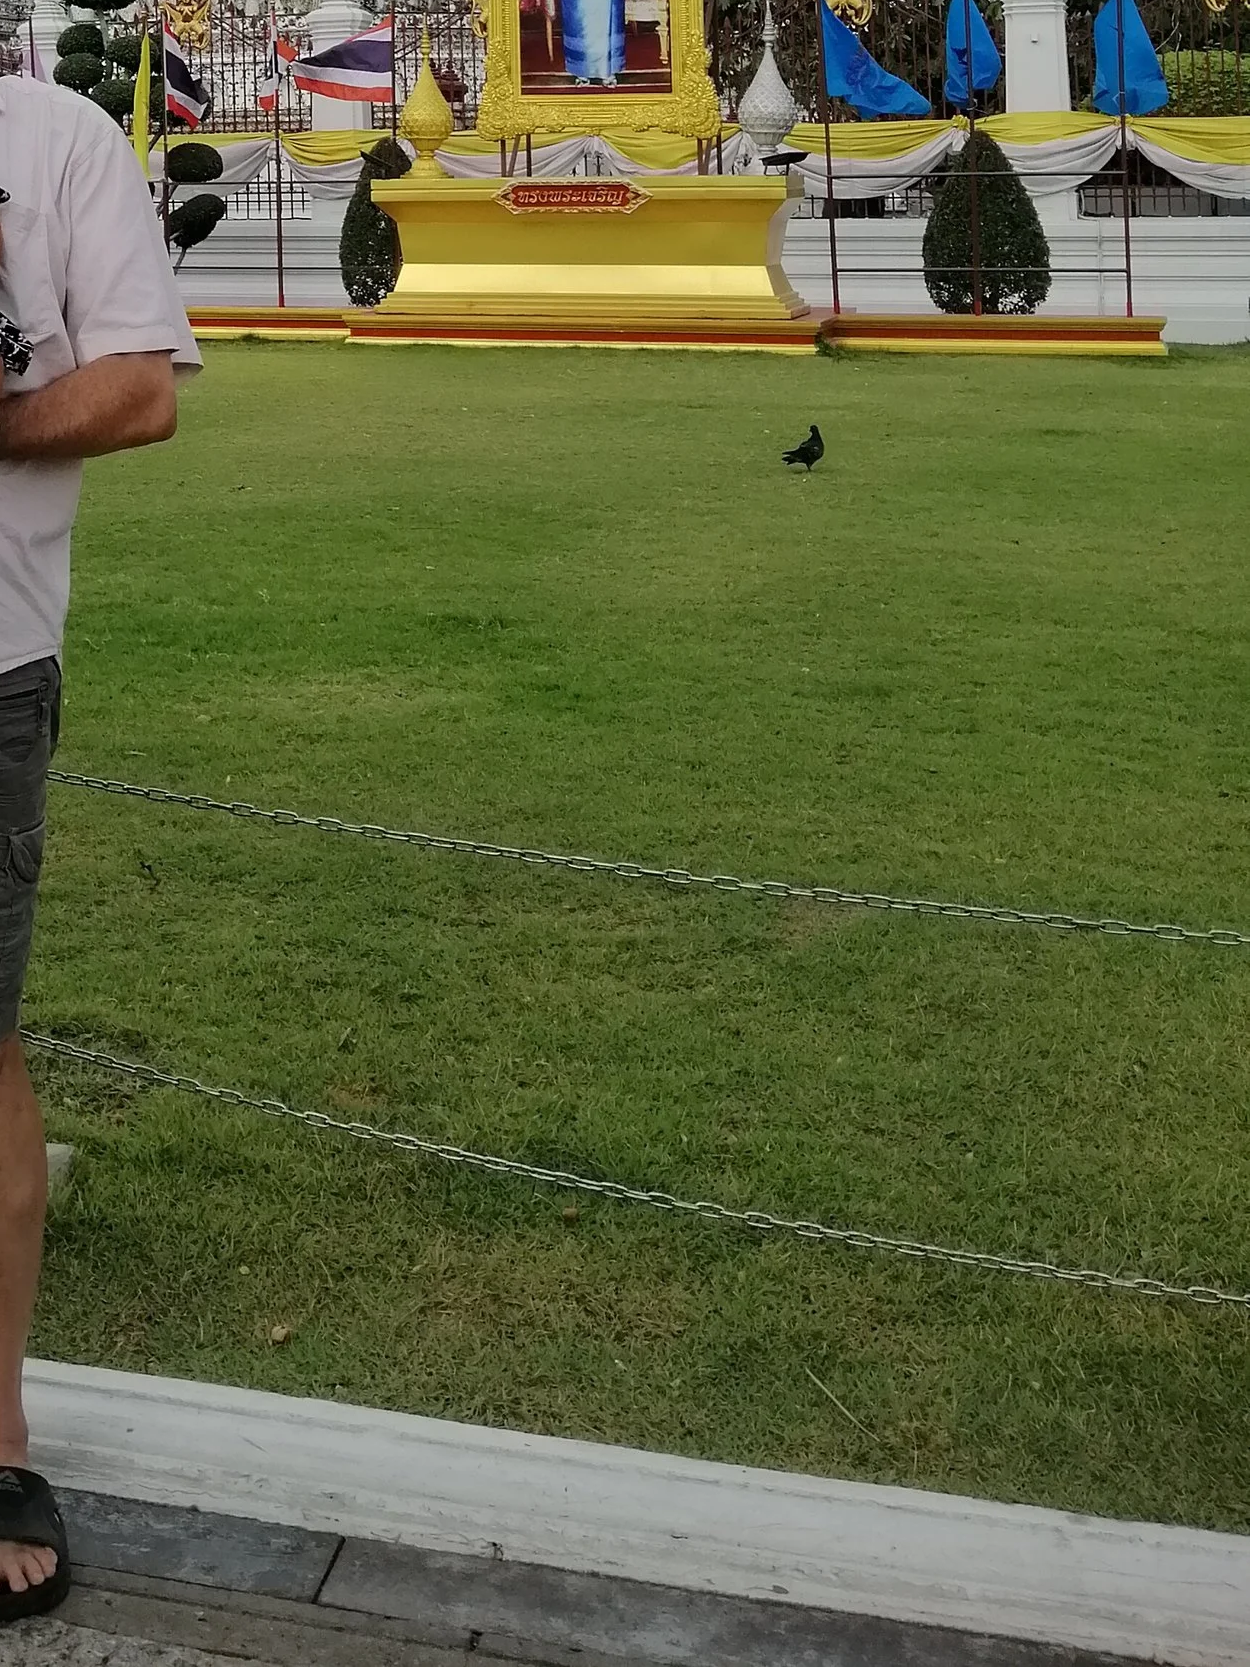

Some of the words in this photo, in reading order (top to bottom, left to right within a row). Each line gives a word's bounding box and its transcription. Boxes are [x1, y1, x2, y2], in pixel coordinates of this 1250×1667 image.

[517, 186, 624, 205] ทรงพระเจริญ
